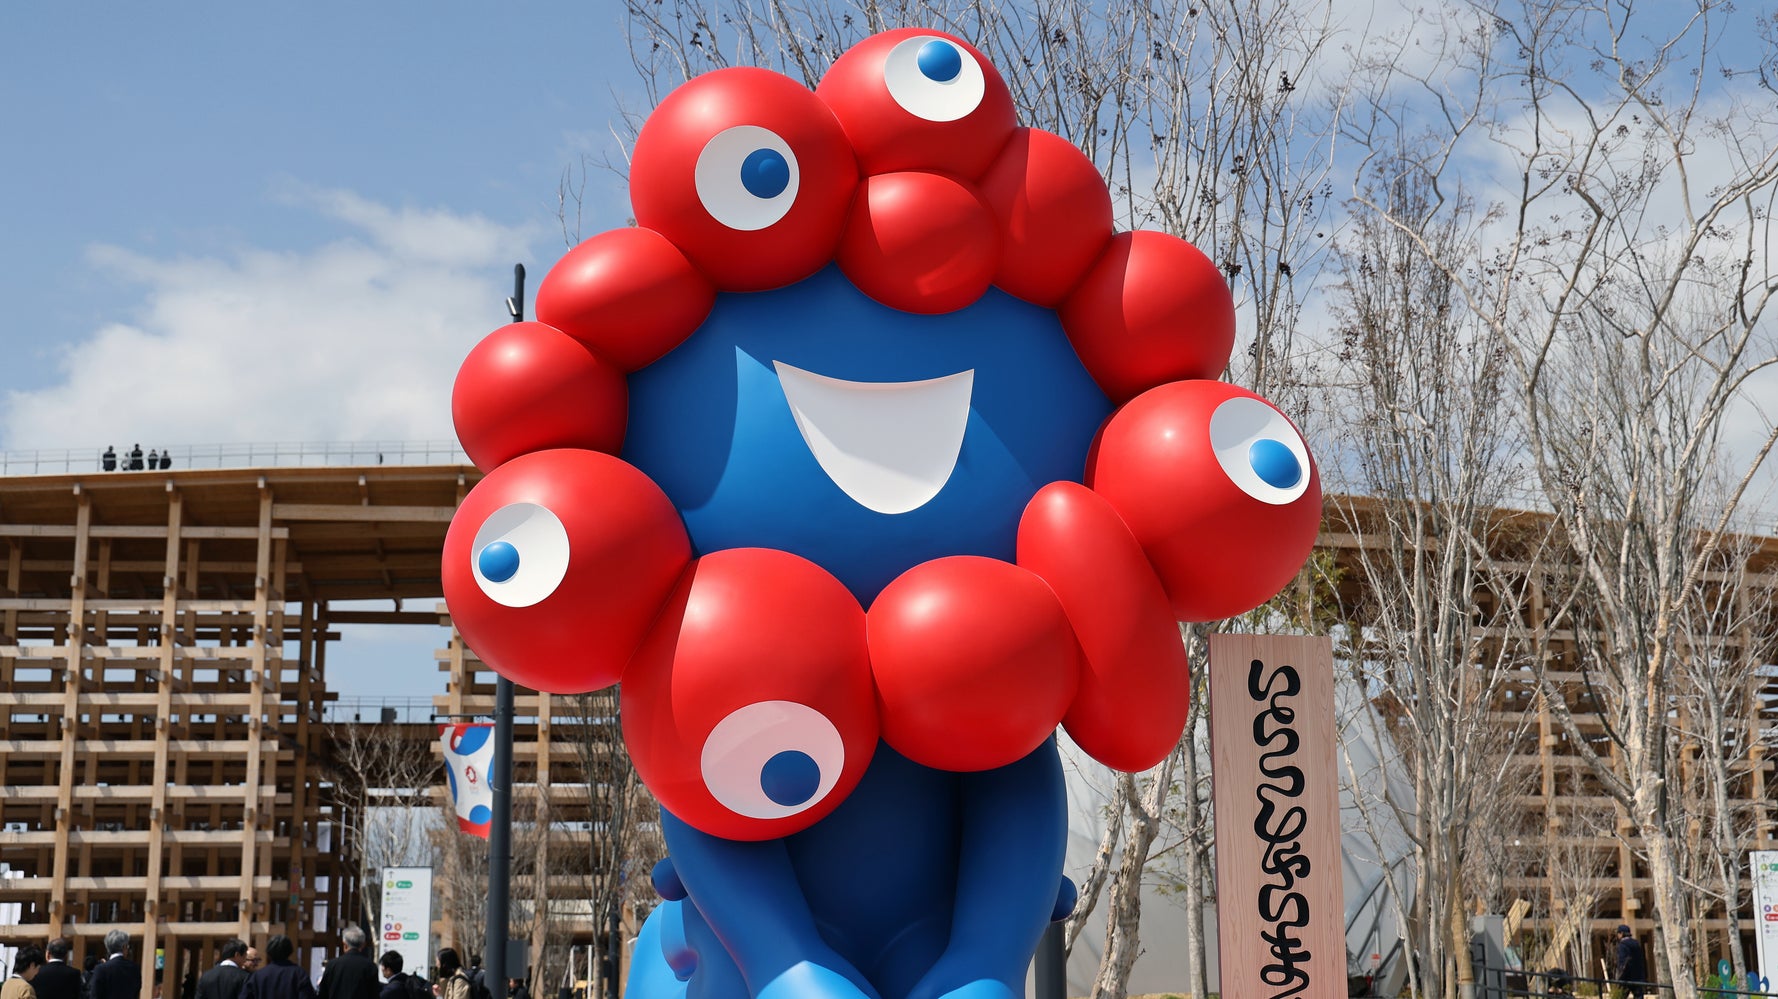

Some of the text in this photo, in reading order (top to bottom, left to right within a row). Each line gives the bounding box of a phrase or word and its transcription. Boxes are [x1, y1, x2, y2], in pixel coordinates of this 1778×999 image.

[1248, 660, 1311, 999] いらっしゃいま
